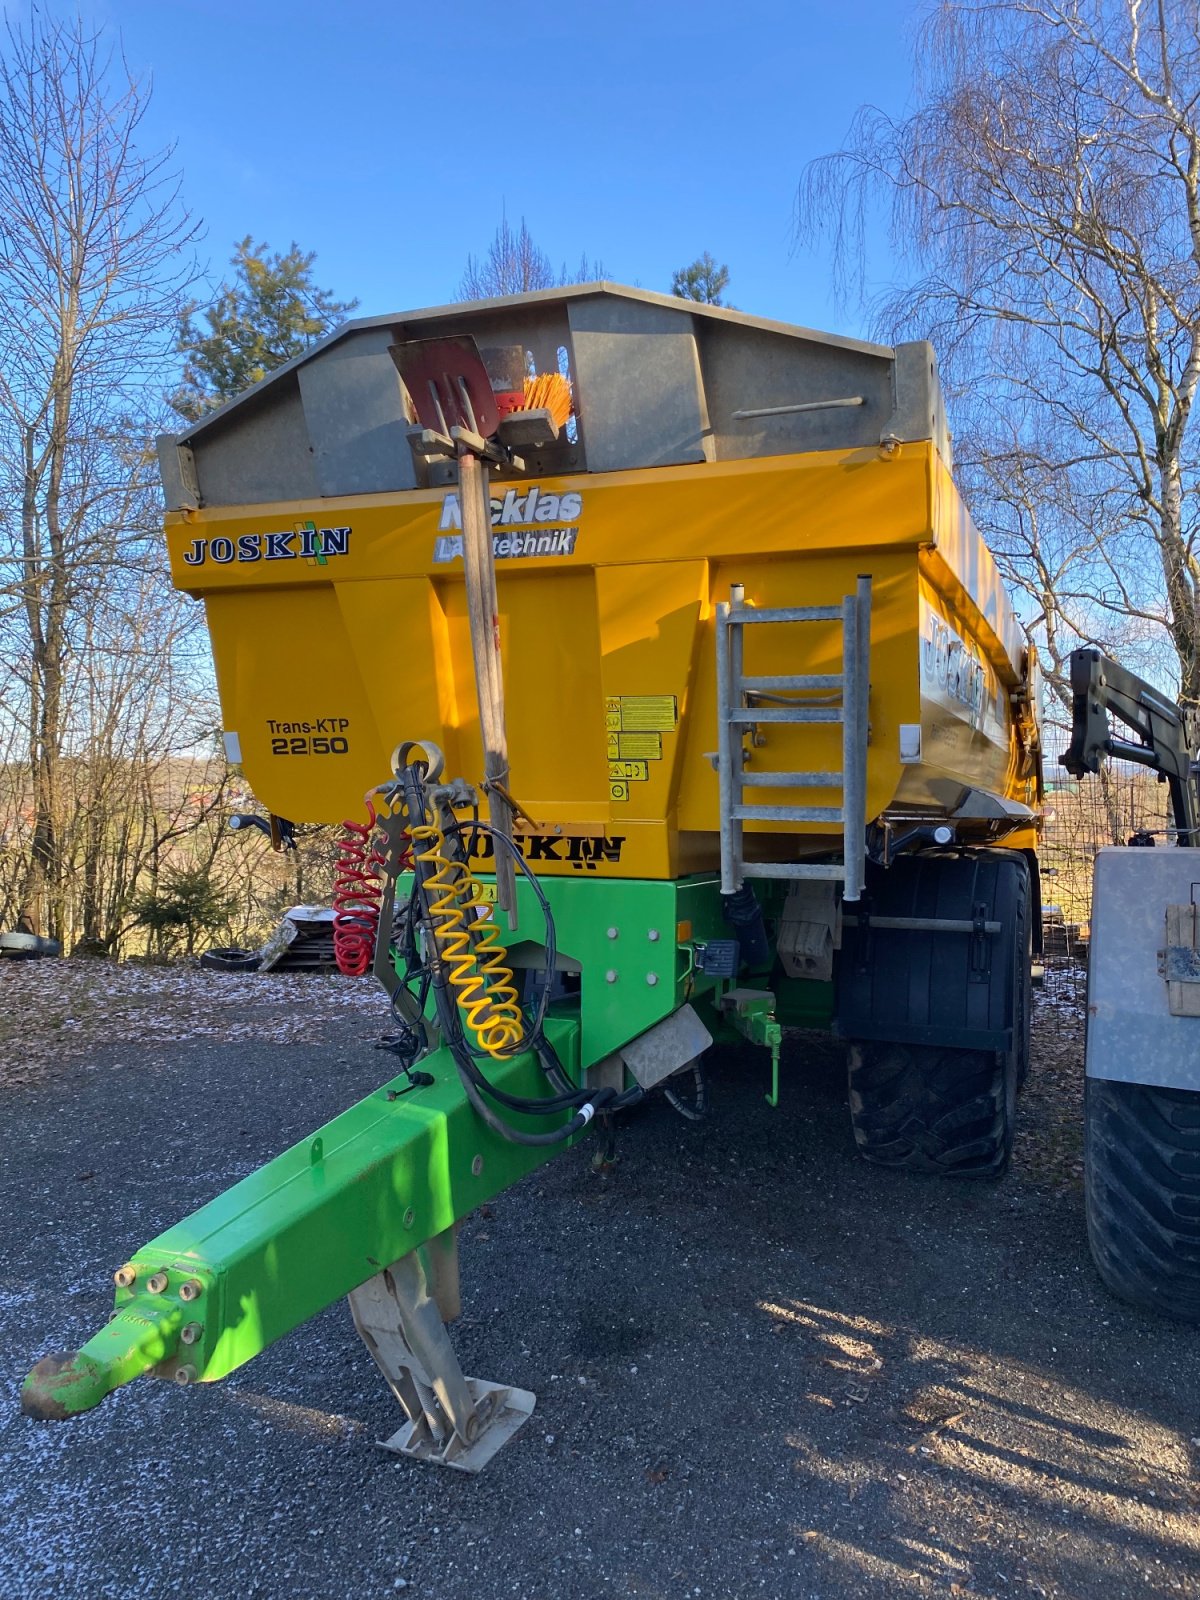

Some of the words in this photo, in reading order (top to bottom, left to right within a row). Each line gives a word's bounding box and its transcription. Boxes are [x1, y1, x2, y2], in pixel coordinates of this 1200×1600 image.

[183, 526, 352, 565] JOSKIN
[438, 530, 573, 559] Latechnik
[266, 718, 349, 734] Trans-KTP
